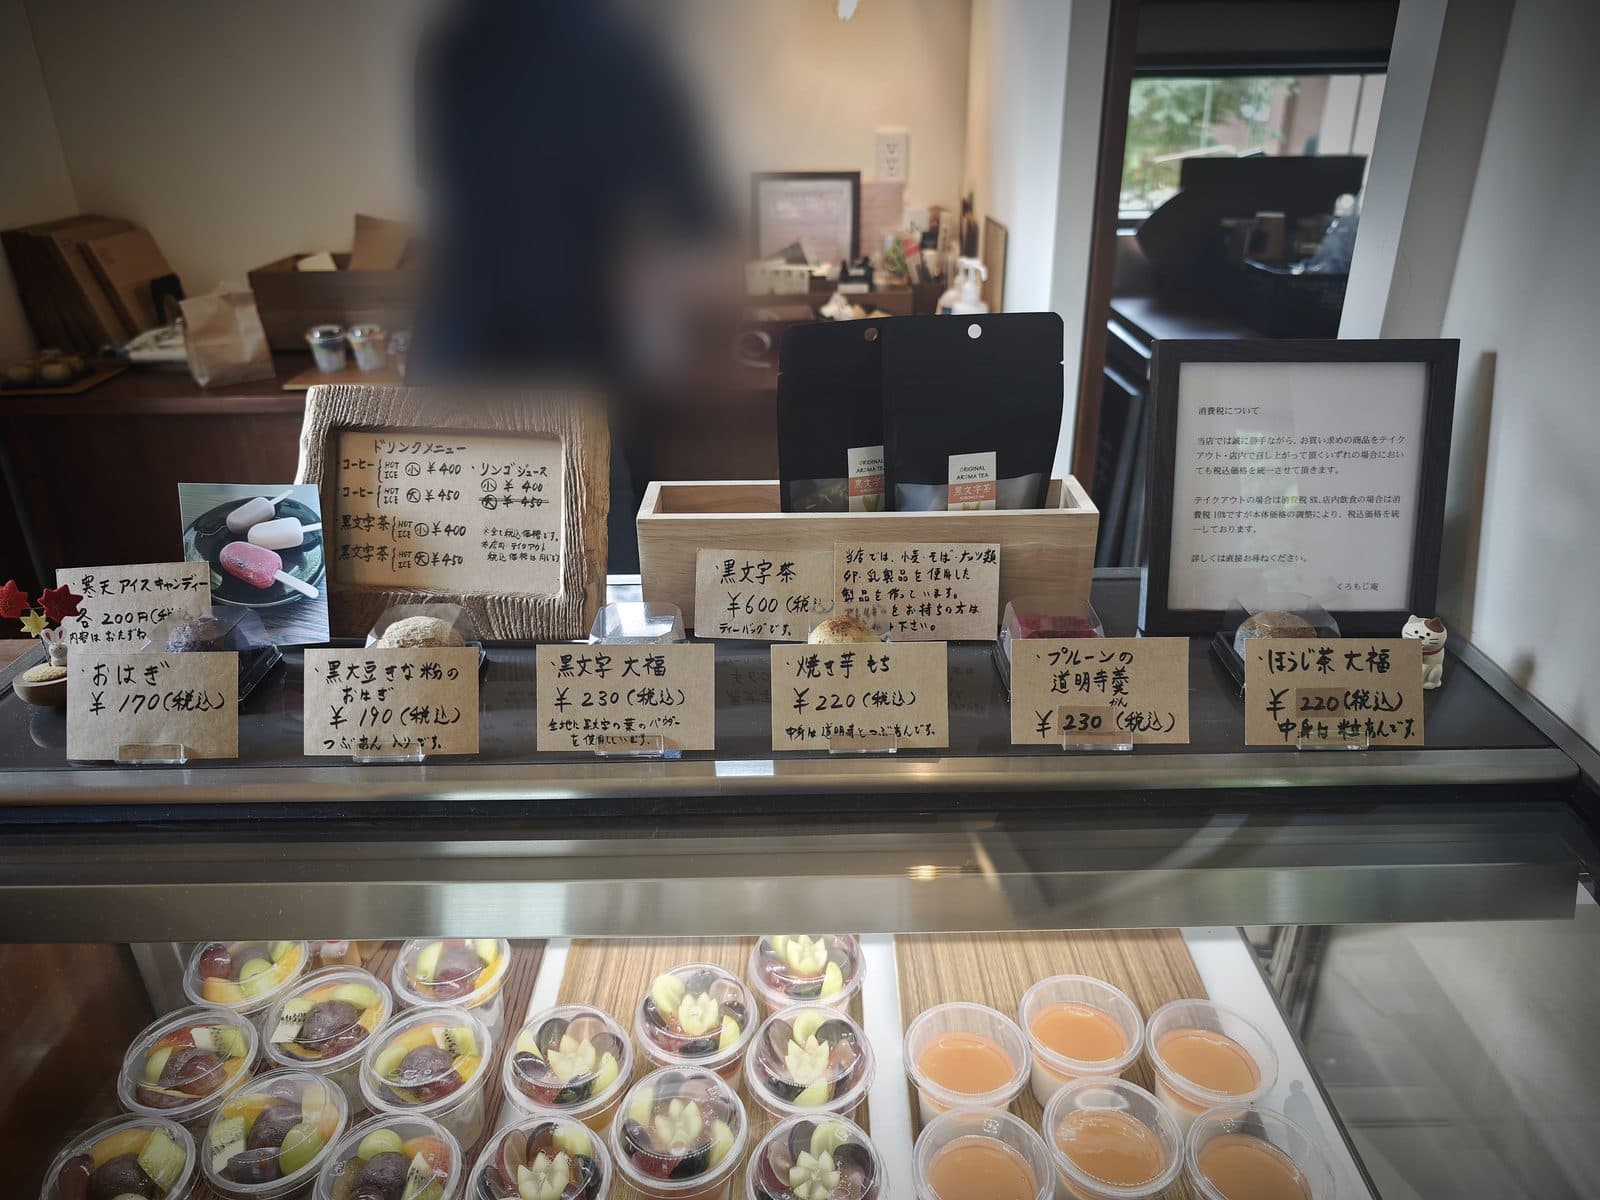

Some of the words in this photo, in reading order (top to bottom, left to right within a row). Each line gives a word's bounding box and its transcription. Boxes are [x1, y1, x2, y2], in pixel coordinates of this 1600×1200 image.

[1198, 406, 1260, 416] 消費税について
[374, 439, 466, 455] ドリンクメニュー
[343, 458, 374, 470] コーヒー
[384, 461, 399, 469] HOT
[481, 461, 549, 478] リンゴジュース
[384, 470, 399, 479] ICE
[343, 486, 374, 498] コーヒー
[384, 496, 399, 504] ICE
[340, 514, 390, 531] 黒文字茶
[398, 530, 411, 539] ICE
[338, 544, 389, 562] 黒文字茶
[398, 550, 413, 558] HOT
[398, 560, 411, 569] ICE
[720, 559, 796, 585] 黒文字茶
[81, 573, 209, 598] 寒天アイスキャンディー
[1336, 581, 1379, 591] くろもじ庵
[1048, 646, 1133, 666] プルーンの
[92, 660, 170, 686] おはぎ
[342, 685, 394, 705] おはぎ
